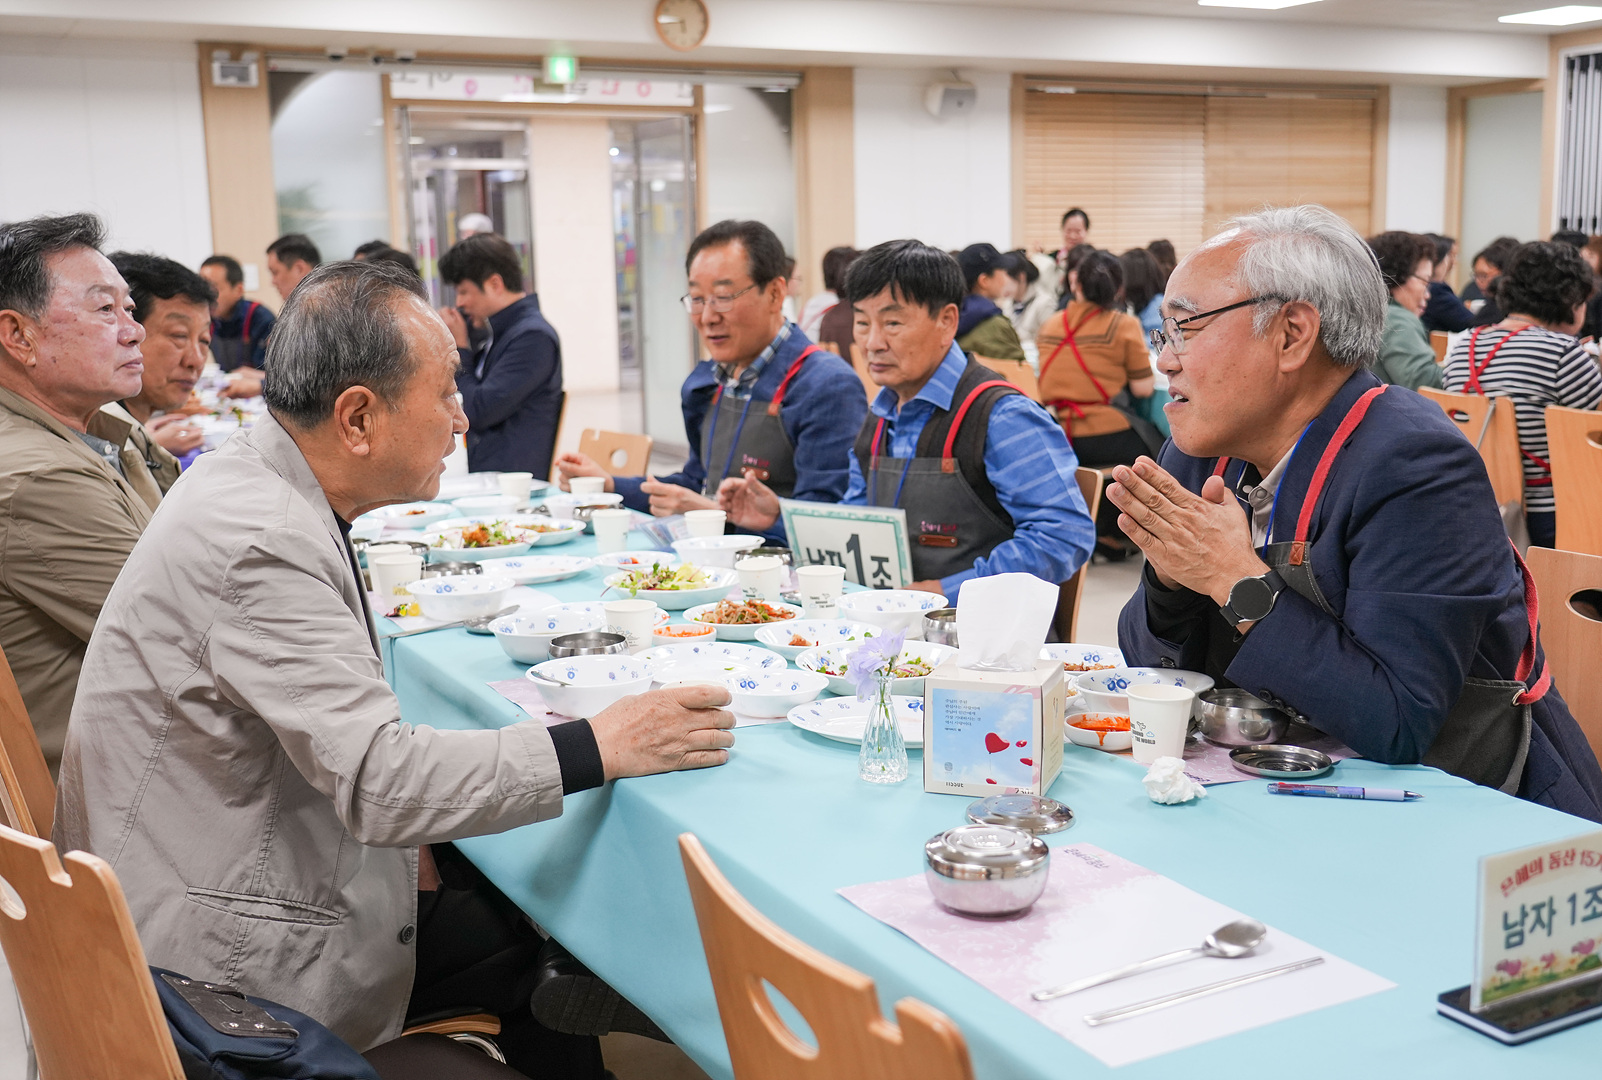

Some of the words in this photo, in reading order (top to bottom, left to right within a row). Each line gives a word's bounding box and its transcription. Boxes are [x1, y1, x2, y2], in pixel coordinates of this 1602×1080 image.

[1500, 856, 1543, 898] 은혜의
[1548, 848, 1576, 870] 동산
[1503, 895, 1557, 950] 남자
[1566, 884, 1602, 926] 1조
